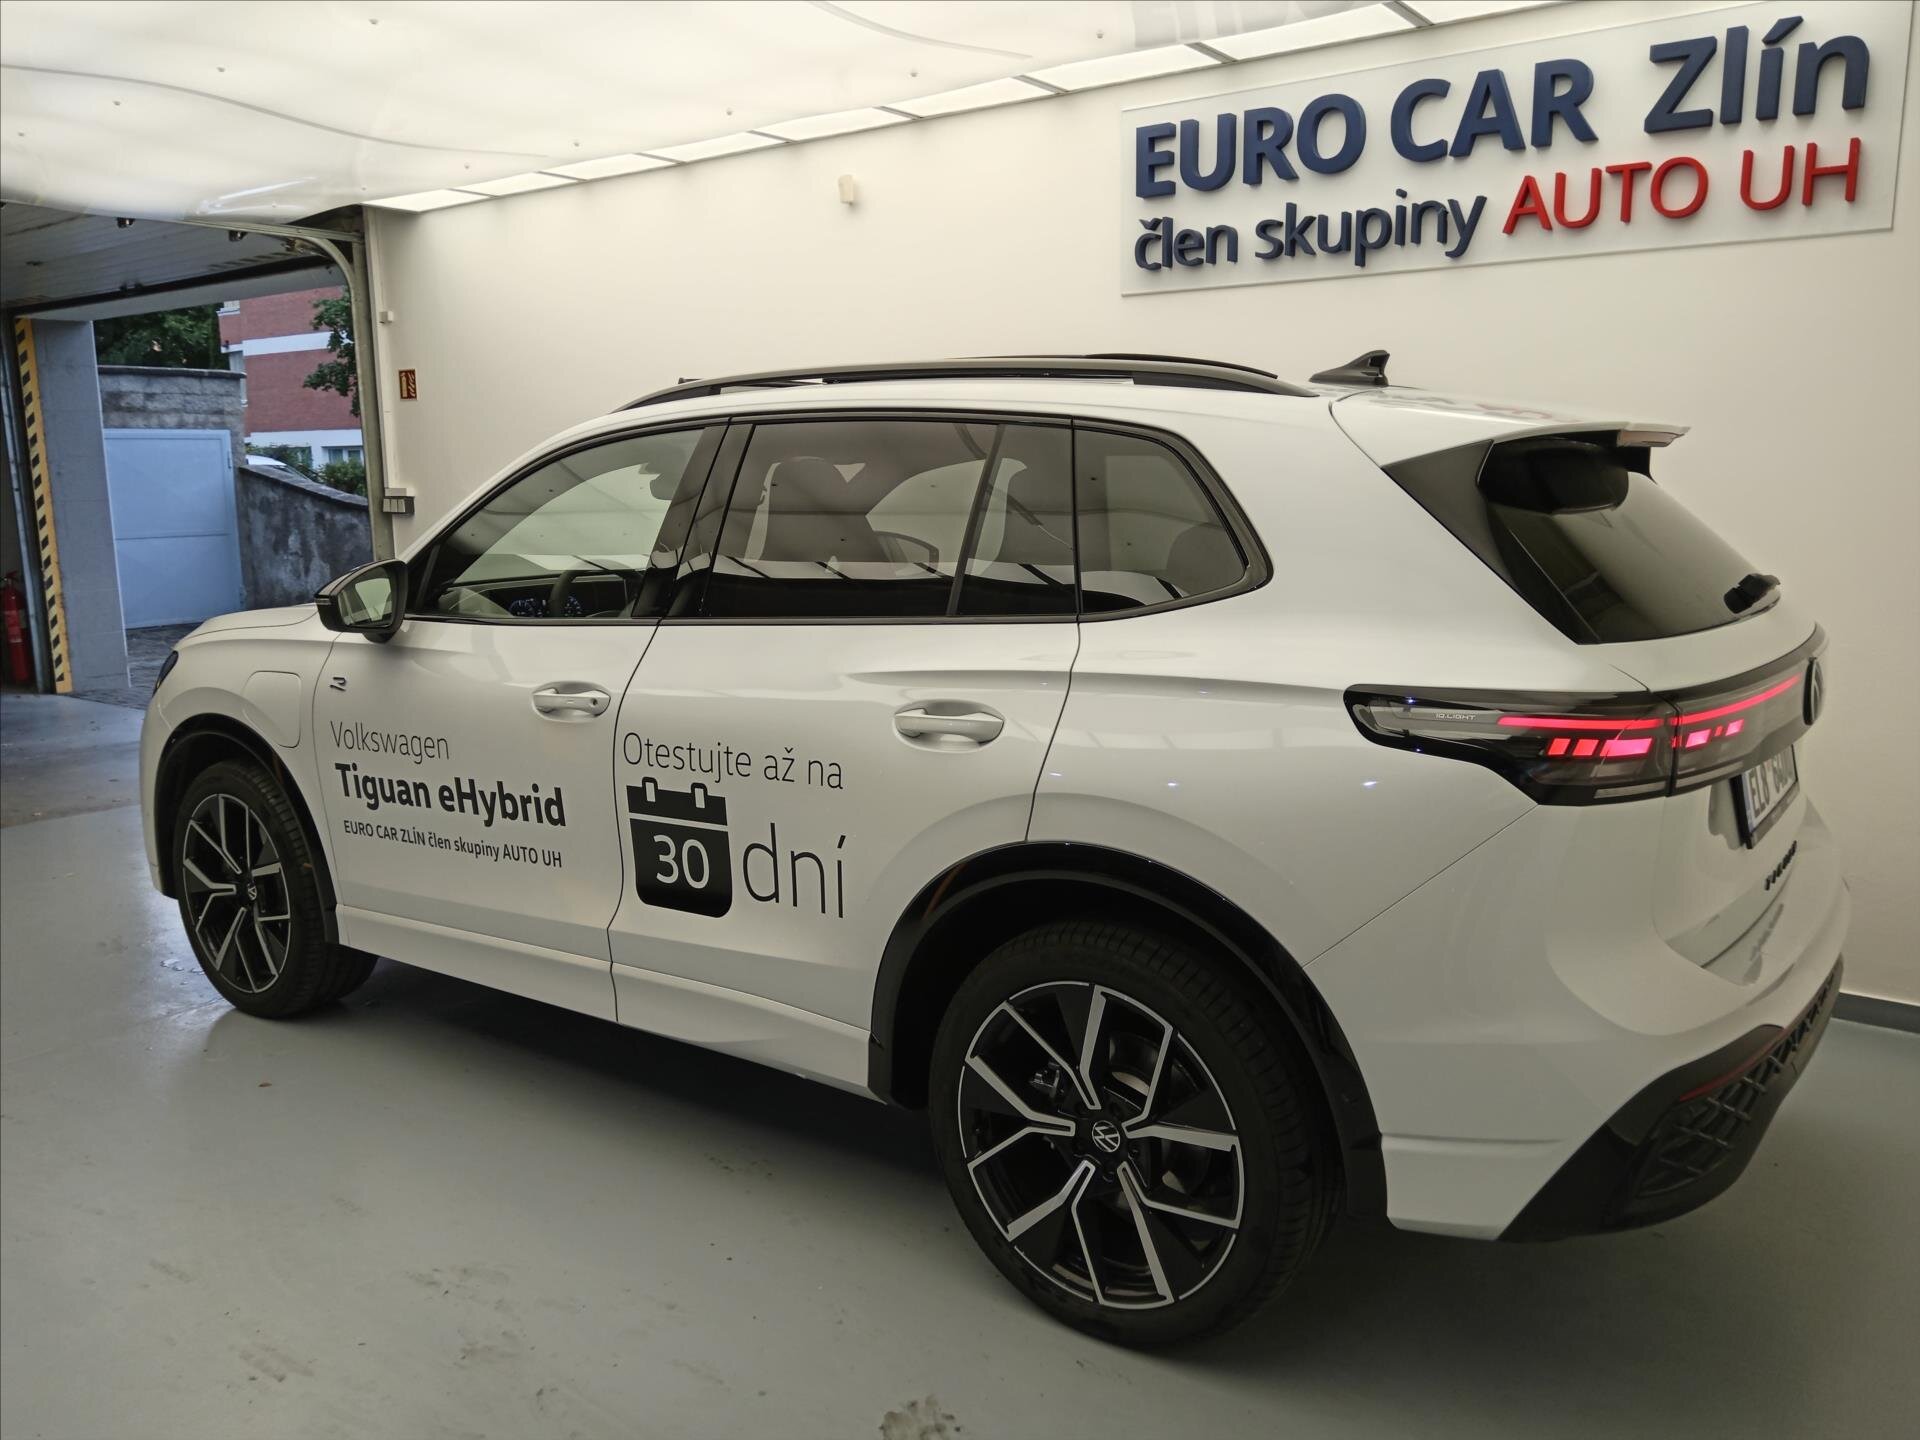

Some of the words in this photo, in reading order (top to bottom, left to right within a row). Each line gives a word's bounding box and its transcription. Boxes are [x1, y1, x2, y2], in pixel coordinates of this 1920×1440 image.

[1135, 93, 1367, 200] EURO
[1390, 58, 1598, 163] CAR
[1643, 16, 1870, 135] Zlín
[1134, 216, 1239, 271] člen
[1255, 189, 1487, 268] skupiny
[1502, 156, 1708, 236] AUTO
[1740, 136, 1861, 211] UH
[330, 720, 450, 765] Volkswagen
[622, 731, 752, 783] Otestujte
[763, 746, 796, 783] až
[807, 755, 844, 790] na
[334, 762, 432, 811] Tiguan
[438, 776, 567, 828] eHybrid
[343, 819, 374, 838] EURO
[376, 824, 400, 842] CAR
[428, 831, 452, 851] člen
[453, 836, 500, 863] skupiny
[502, 843, 539, 865] AUTO
[541, 848, 563, 869] UH
[652, 833, 711, 889] 30
[742, 822, 847, 918] dní
